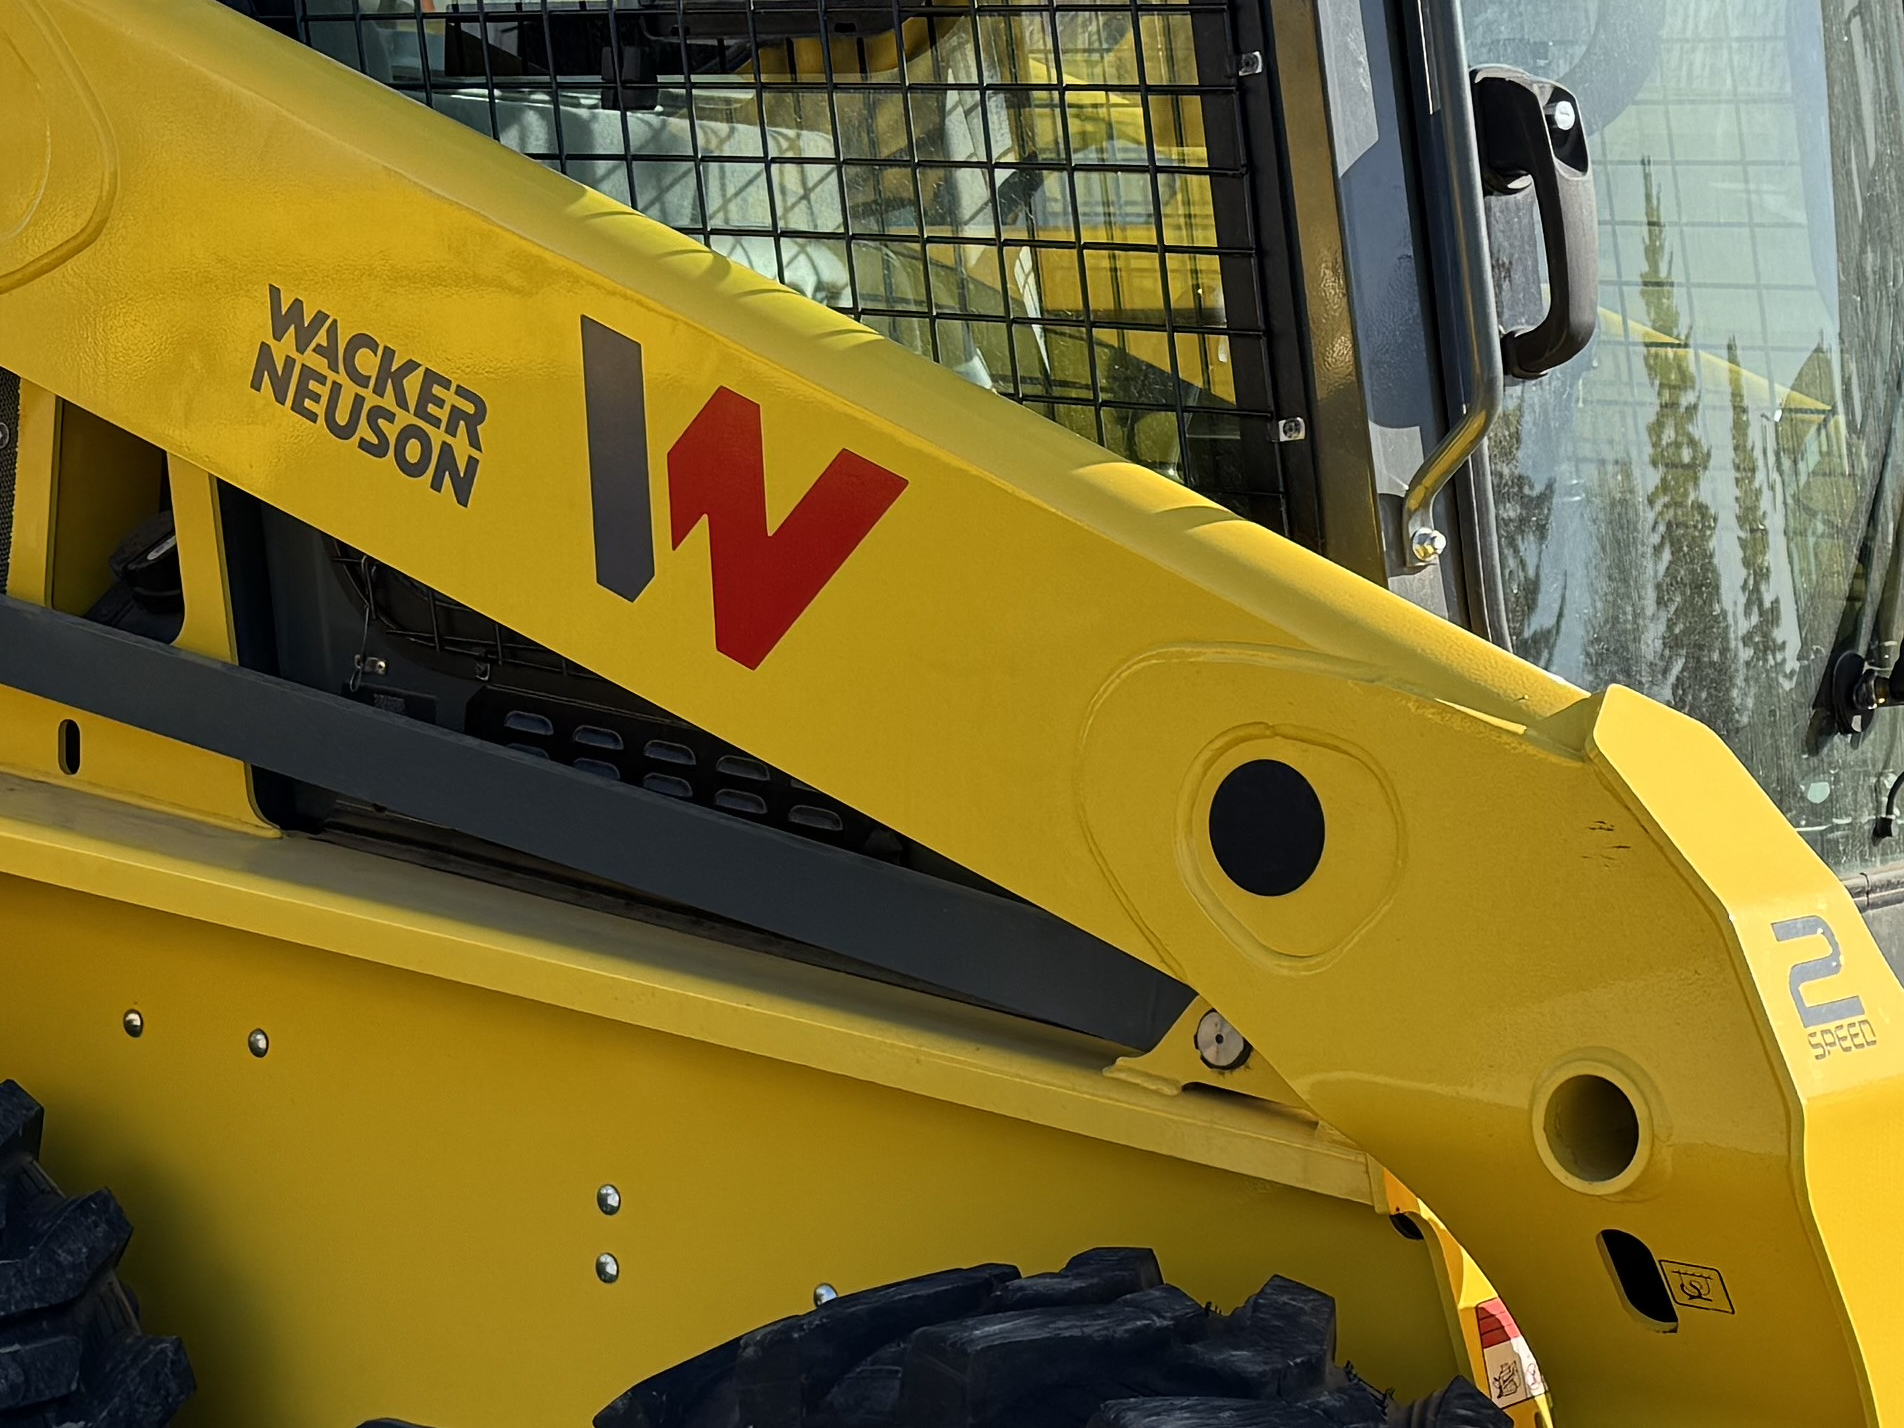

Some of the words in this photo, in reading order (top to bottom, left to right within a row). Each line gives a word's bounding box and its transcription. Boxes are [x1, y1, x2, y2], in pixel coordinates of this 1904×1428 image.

[249, 341, 480, 508] NEUSON
[268, 283, 488, 453] WACKER
[1771, 915, 1866, 1028] 2
[1807, 1019, 1877, 1060] SPEED
